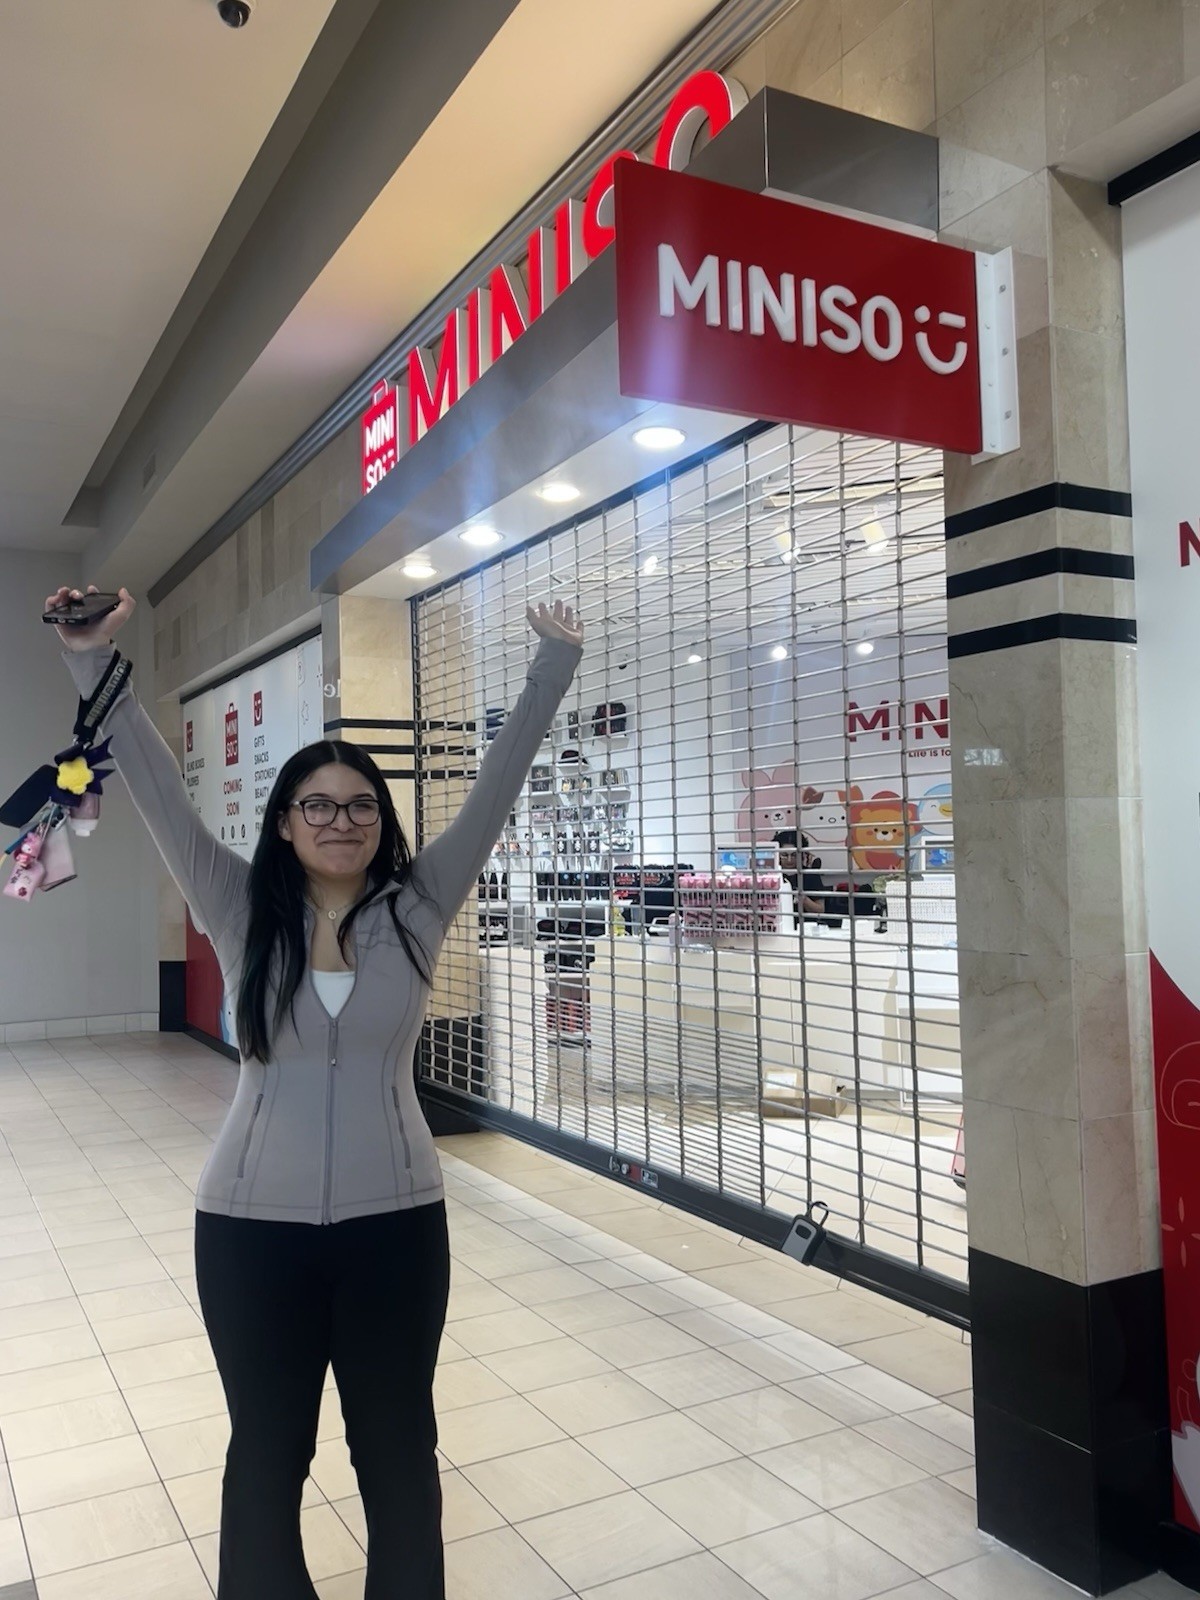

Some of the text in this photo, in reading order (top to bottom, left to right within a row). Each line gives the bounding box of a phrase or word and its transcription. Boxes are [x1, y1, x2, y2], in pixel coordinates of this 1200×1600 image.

[657, 243, 903, 362] MINISO
[365, 405, 395, 458] MINI
[254, 734, 265, 748] GIFTS
[254, 751, 269, 765] SNACKS
[254, 766, 277, 782] STATIONERY
[223, 778, 242, 795] COMING
[254, 786, 269, 799] BEAUTY
[226, 801, 240, 817] SOON
